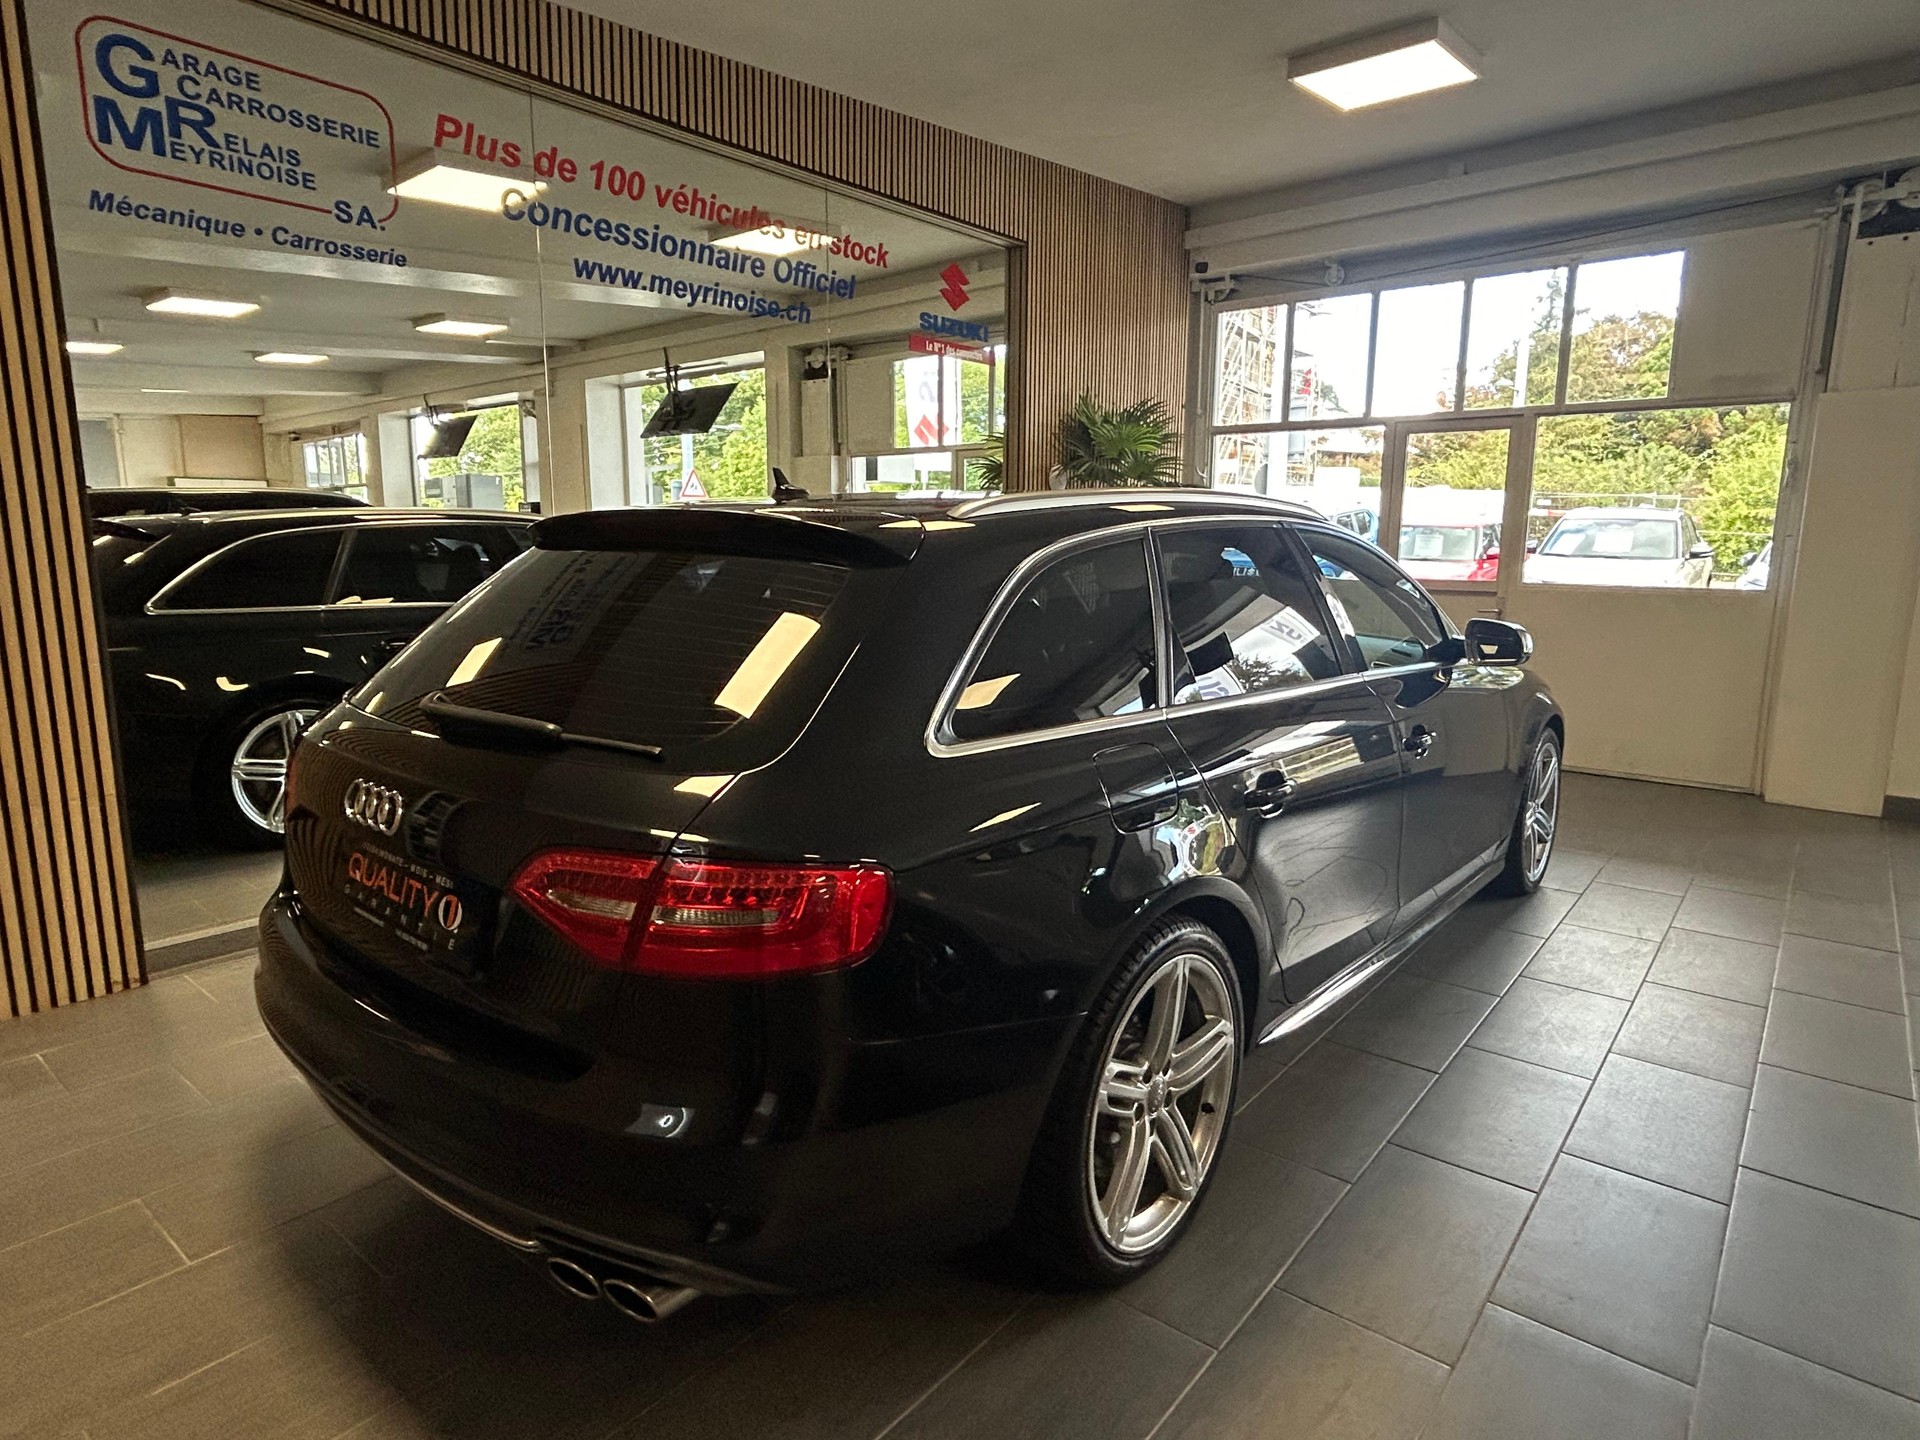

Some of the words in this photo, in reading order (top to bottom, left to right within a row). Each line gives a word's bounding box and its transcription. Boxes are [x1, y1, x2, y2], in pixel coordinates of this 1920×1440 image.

[177, 75, 381, 149] CARROSSERIE
[333, 200, 387, 232] SA.
[434, 113, 522, 167] Plus
[533, 146, 578, 183] de
[589, 160, 646, 201] 100
[655, 184, 787, 240] véhicules
[794, 225, 823, 251] en
[829, 233, 890, 268] stock
[89, 189, 246, 237] Mécanique
[271, 226, 408, 268] Carrosserie
[500, 188, 766, 278] Concessionnaire
[773, 256, 857, 300] Officiel
[573, 257, 812, 324] www.meyrinoise.ch
[919, 311, 989, 343] SUZUKI
[349, 851, 440, 918] QUALITY
